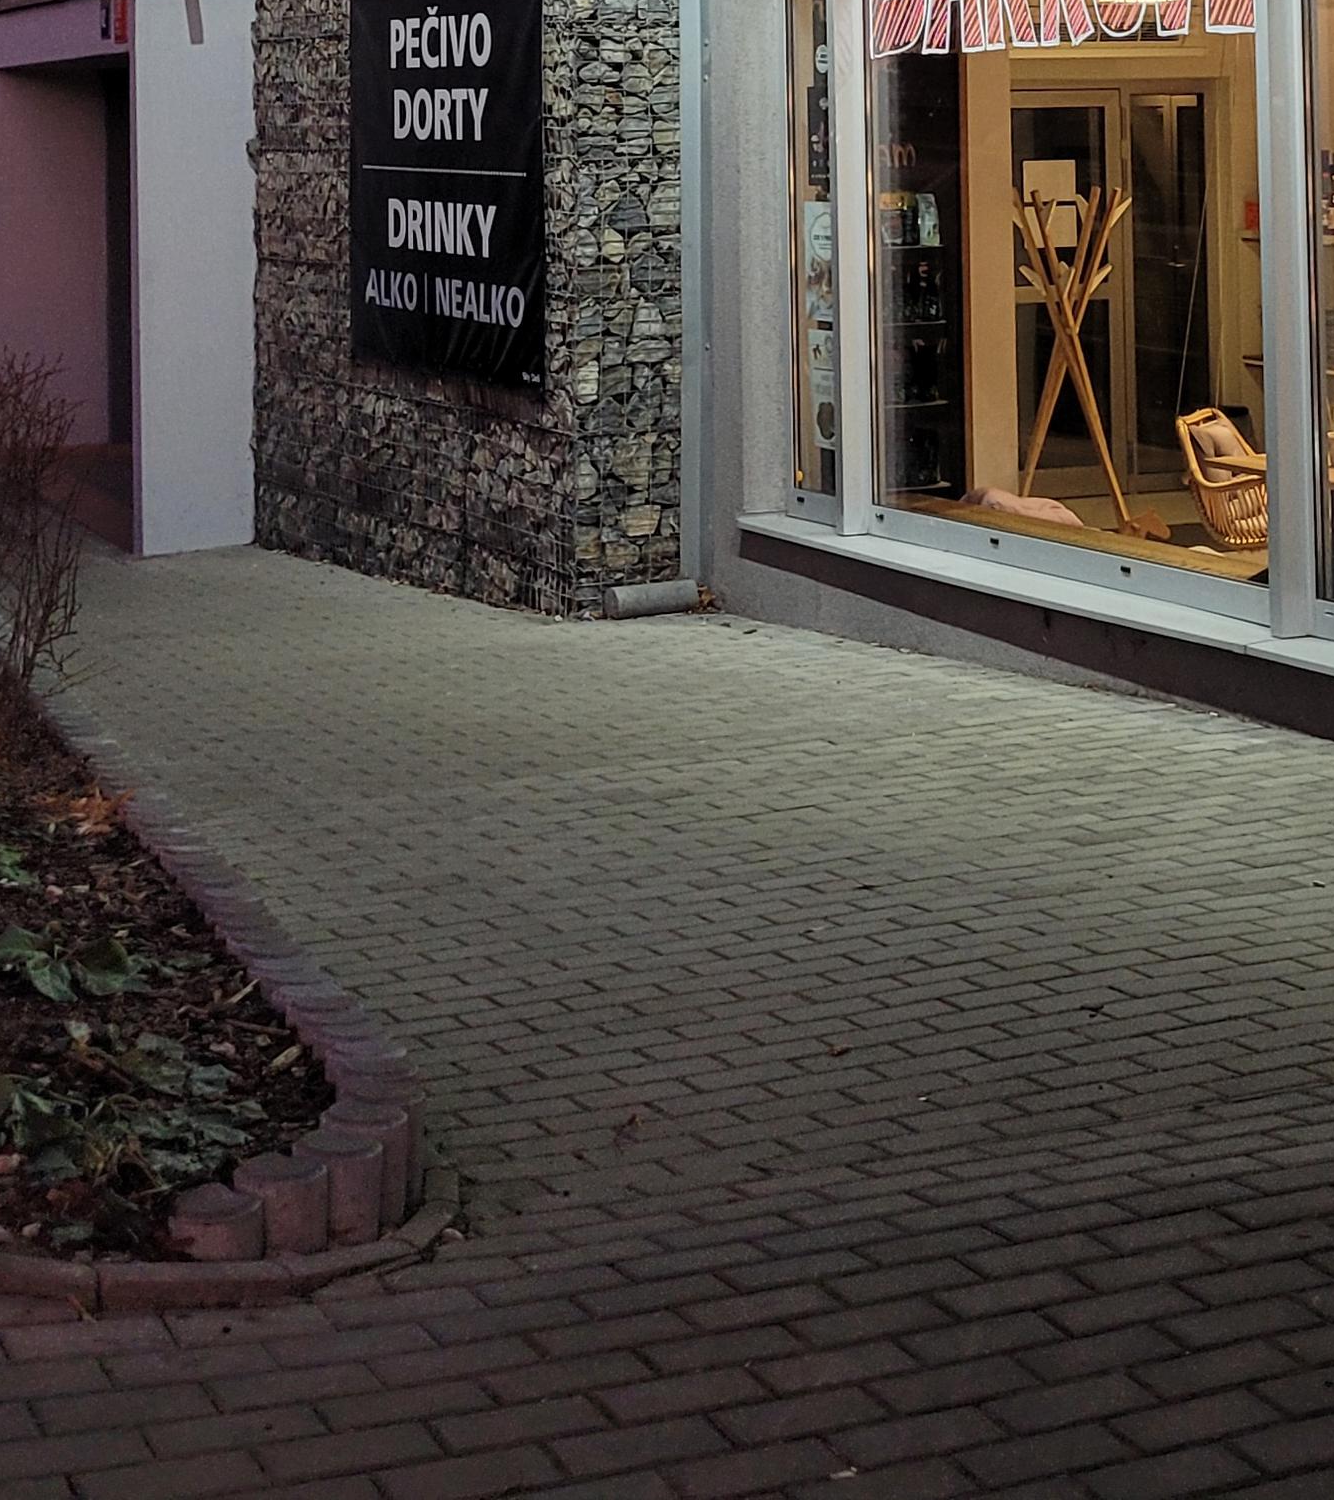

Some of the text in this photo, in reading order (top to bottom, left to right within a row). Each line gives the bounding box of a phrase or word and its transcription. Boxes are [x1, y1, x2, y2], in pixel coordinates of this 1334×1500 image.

[389, 5, 493, 71] PEČIVO
[393, 87, 489, 142] DORTY
[387, 197, 497, 260] DRINKY
[365, 267, 526, 329] ALKO NEALKO
